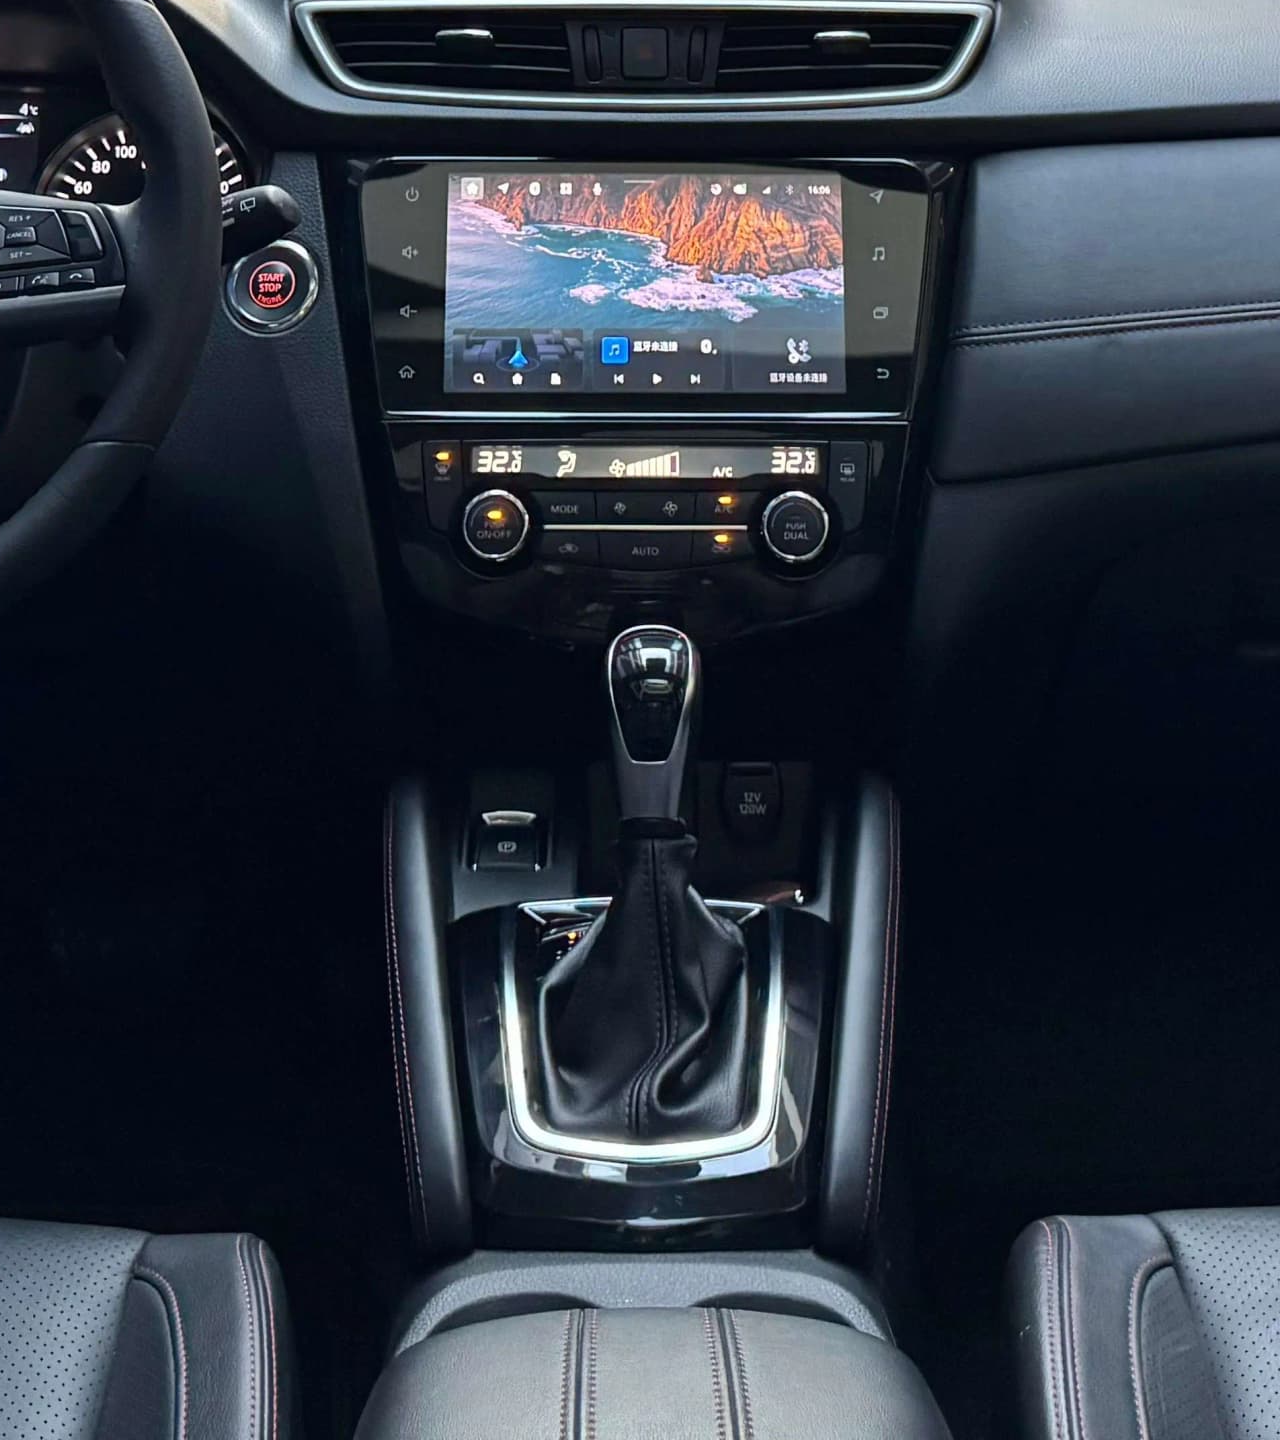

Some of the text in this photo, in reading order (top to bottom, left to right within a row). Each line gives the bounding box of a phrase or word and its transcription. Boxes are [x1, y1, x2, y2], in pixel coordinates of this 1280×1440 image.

[114, 145, 137, 159] 100
[91, 160, 111, 174] 80
[73, 181, 92, 195] 60
[807, 184, 831, 195] 16:06
[258, 273, 285, 282] START
[258, 283, 282, 292] STOP
[712, 466, 733, 478] A/C
[550, 504, 579, 514] MODE
[785, 522, 806, 531] PUSH
[783, 531, 809, 541] DUAL
[632, 546, 660, 557] AUTO
